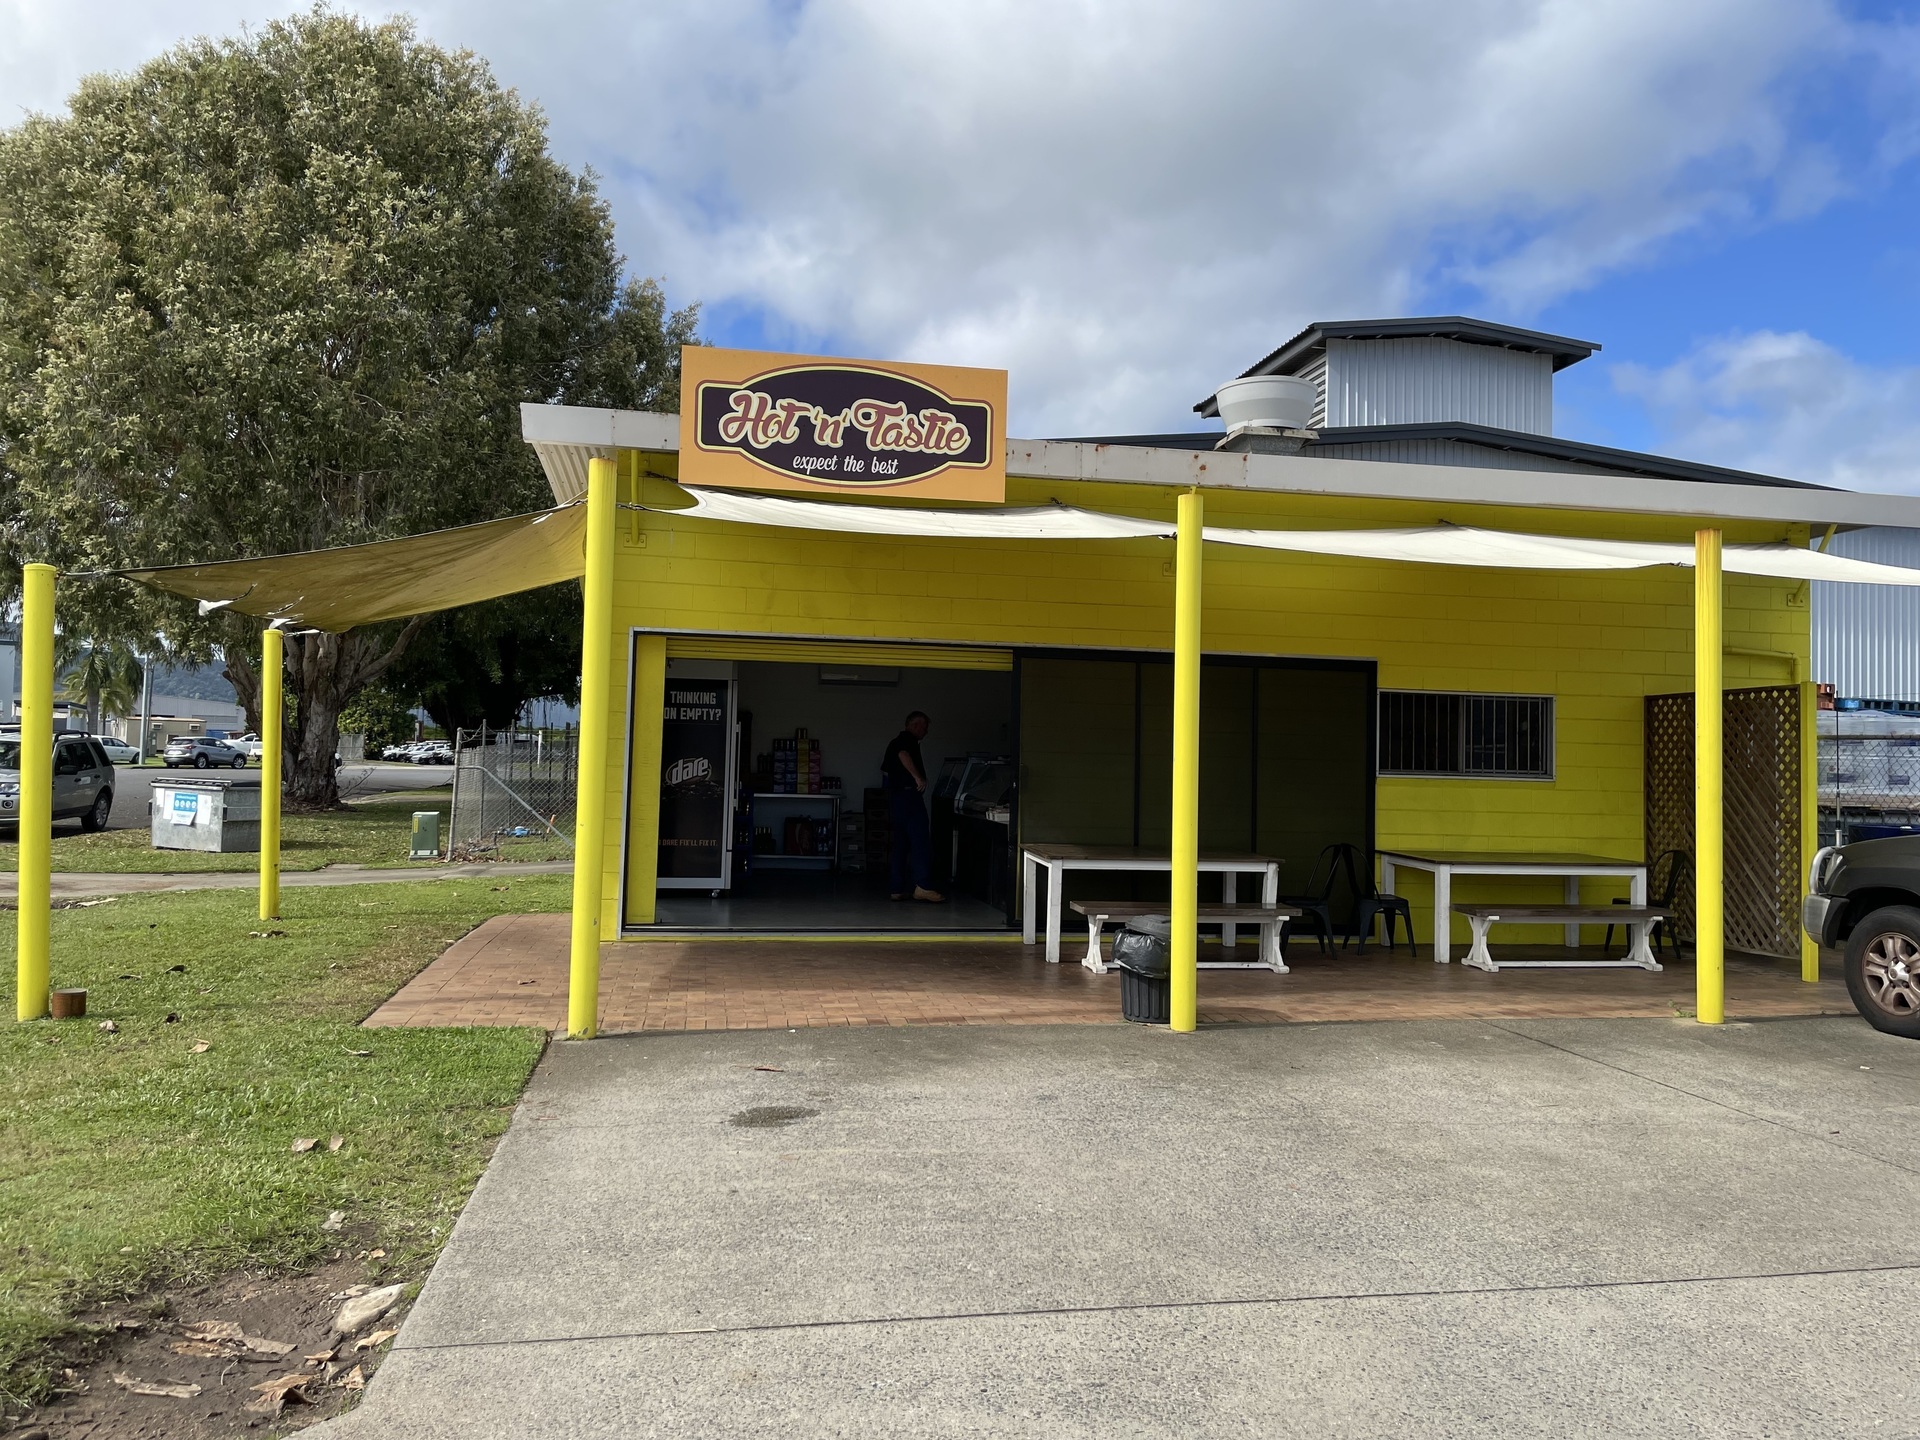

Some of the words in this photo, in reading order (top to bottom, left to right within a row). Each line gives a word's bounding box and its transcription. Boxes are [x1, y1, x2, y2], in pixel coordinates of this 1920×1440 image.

[719, 391, 812, 448] Hot
[851, 398, 971, 454] Tastie
[793, 455, 837, 475] expect
[844, 455, 865, 473] the
[872, 457, 898, 475] best
[670, 691, 716, 704] THINKING
[664, 707, 677, 719] ON
[680, 708, 721, 721] EMPTY?
[672, 757, 708, 784] dare
